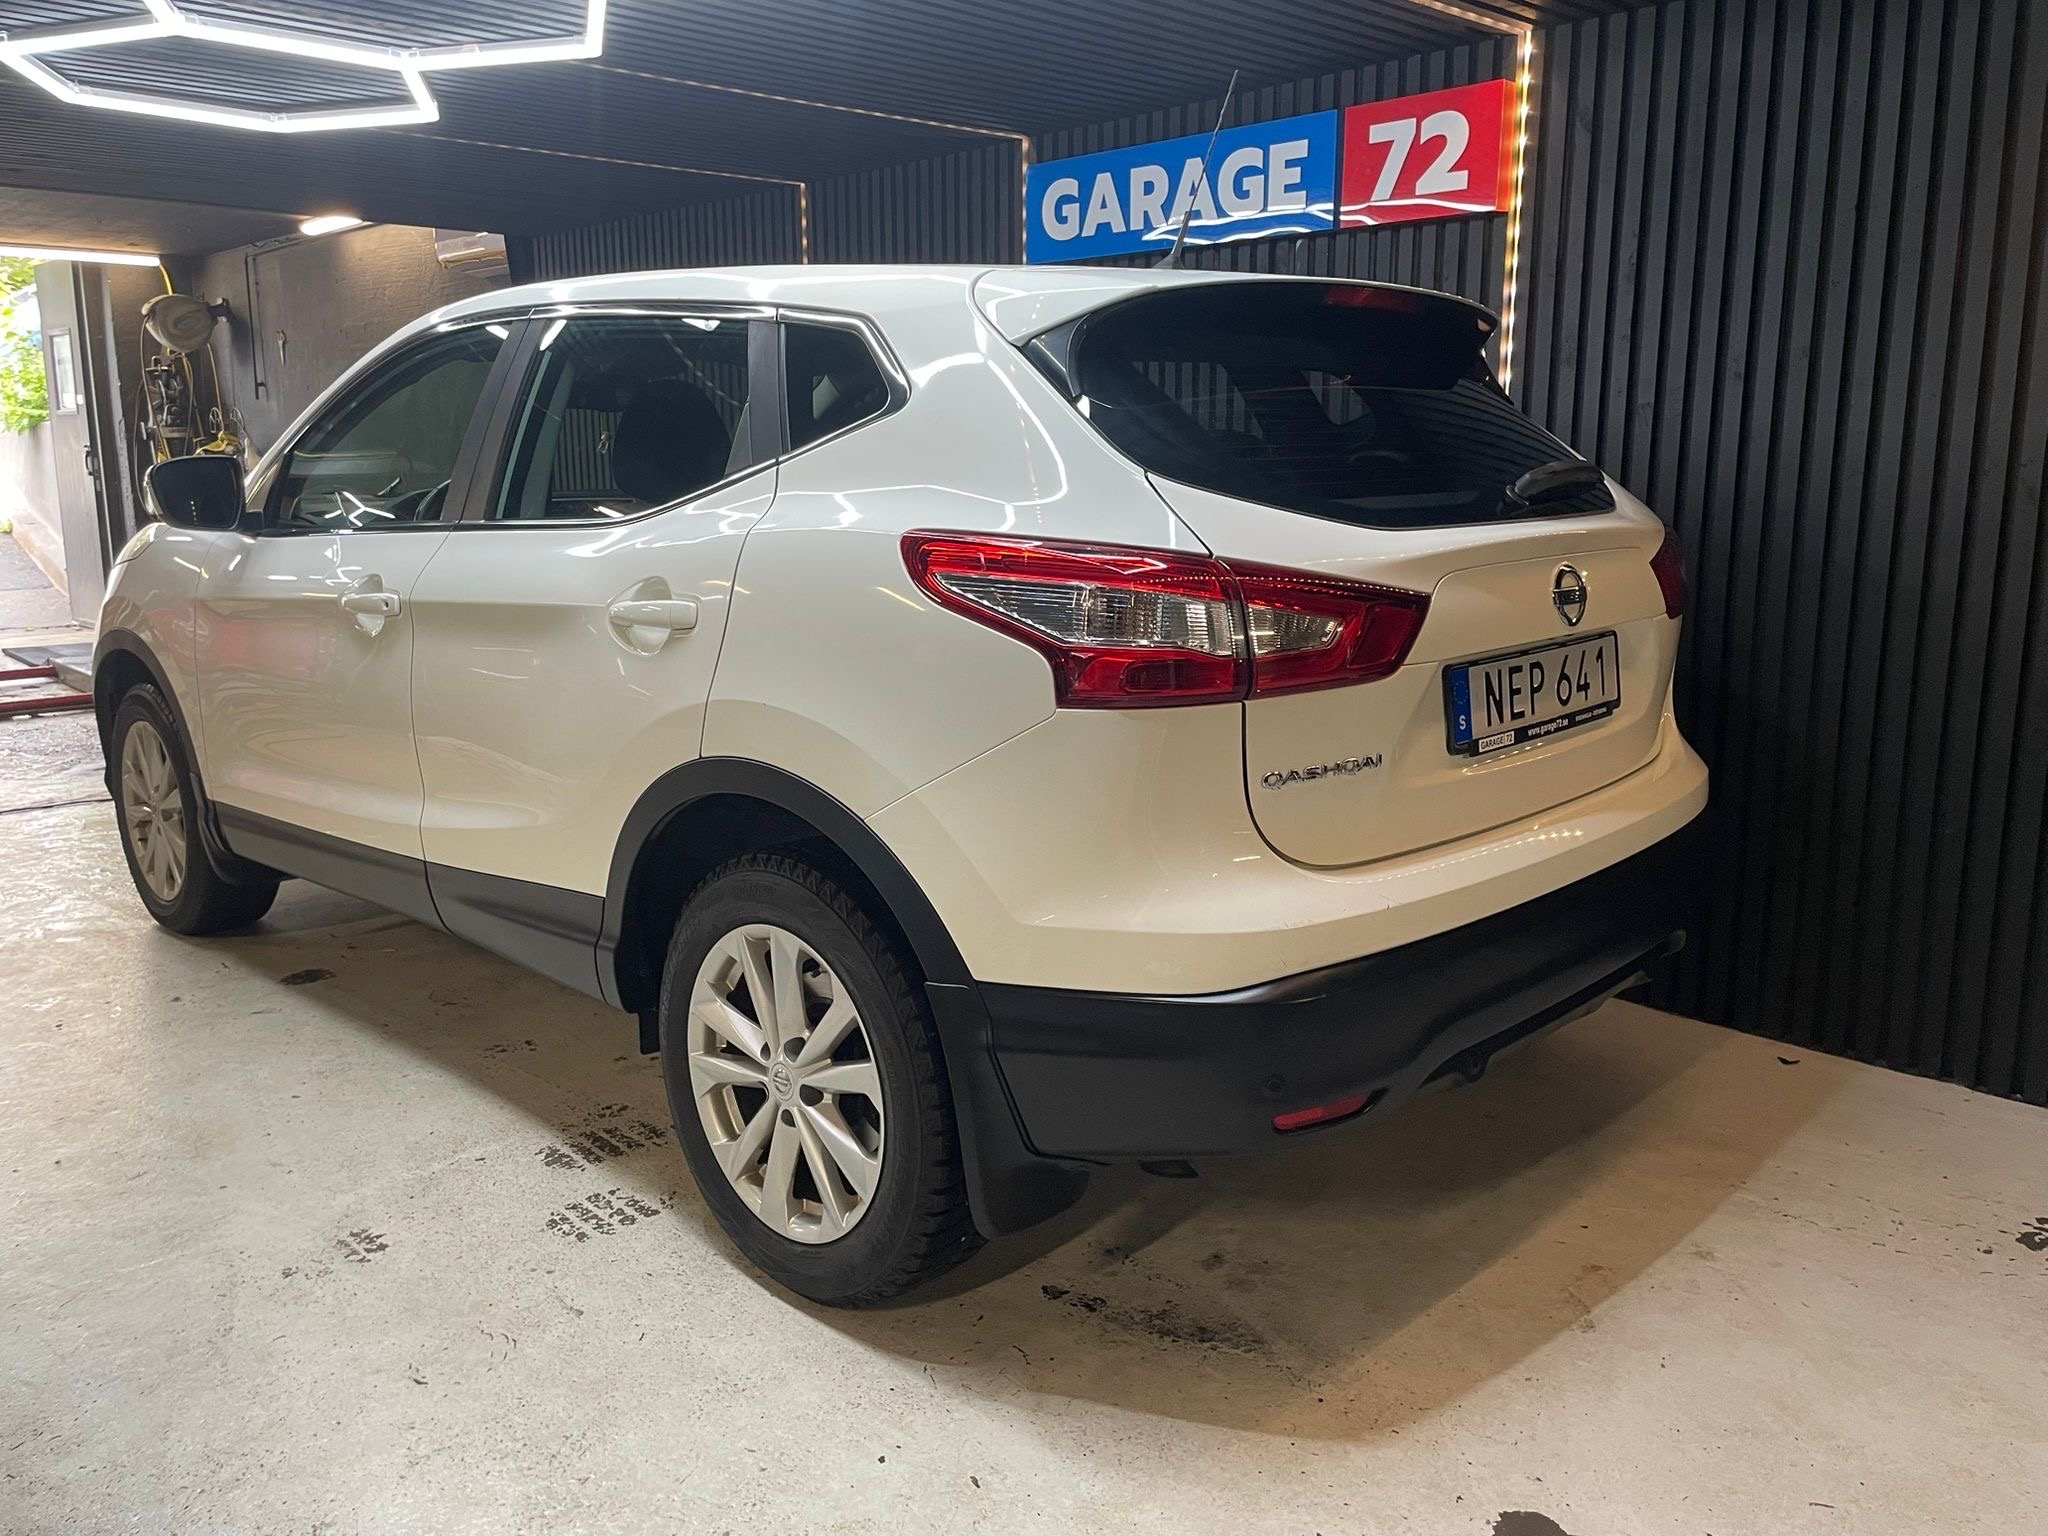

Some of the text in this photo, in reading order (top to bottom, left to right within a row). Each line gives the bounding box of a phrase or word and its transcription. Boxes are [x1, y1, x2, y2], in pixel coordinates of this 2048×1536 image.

[1041, 110, 1470, 241] GARAGE 72
[1484, 646, 1606, 728] NEP 641
[1458, 714, 1467, 731] S
[1527, 718, 1569, 737] www.garage72.se
[1480, 733, 1513, 750] GARAGE 72
[1260, 752, 1383, 790] QASHQAI
